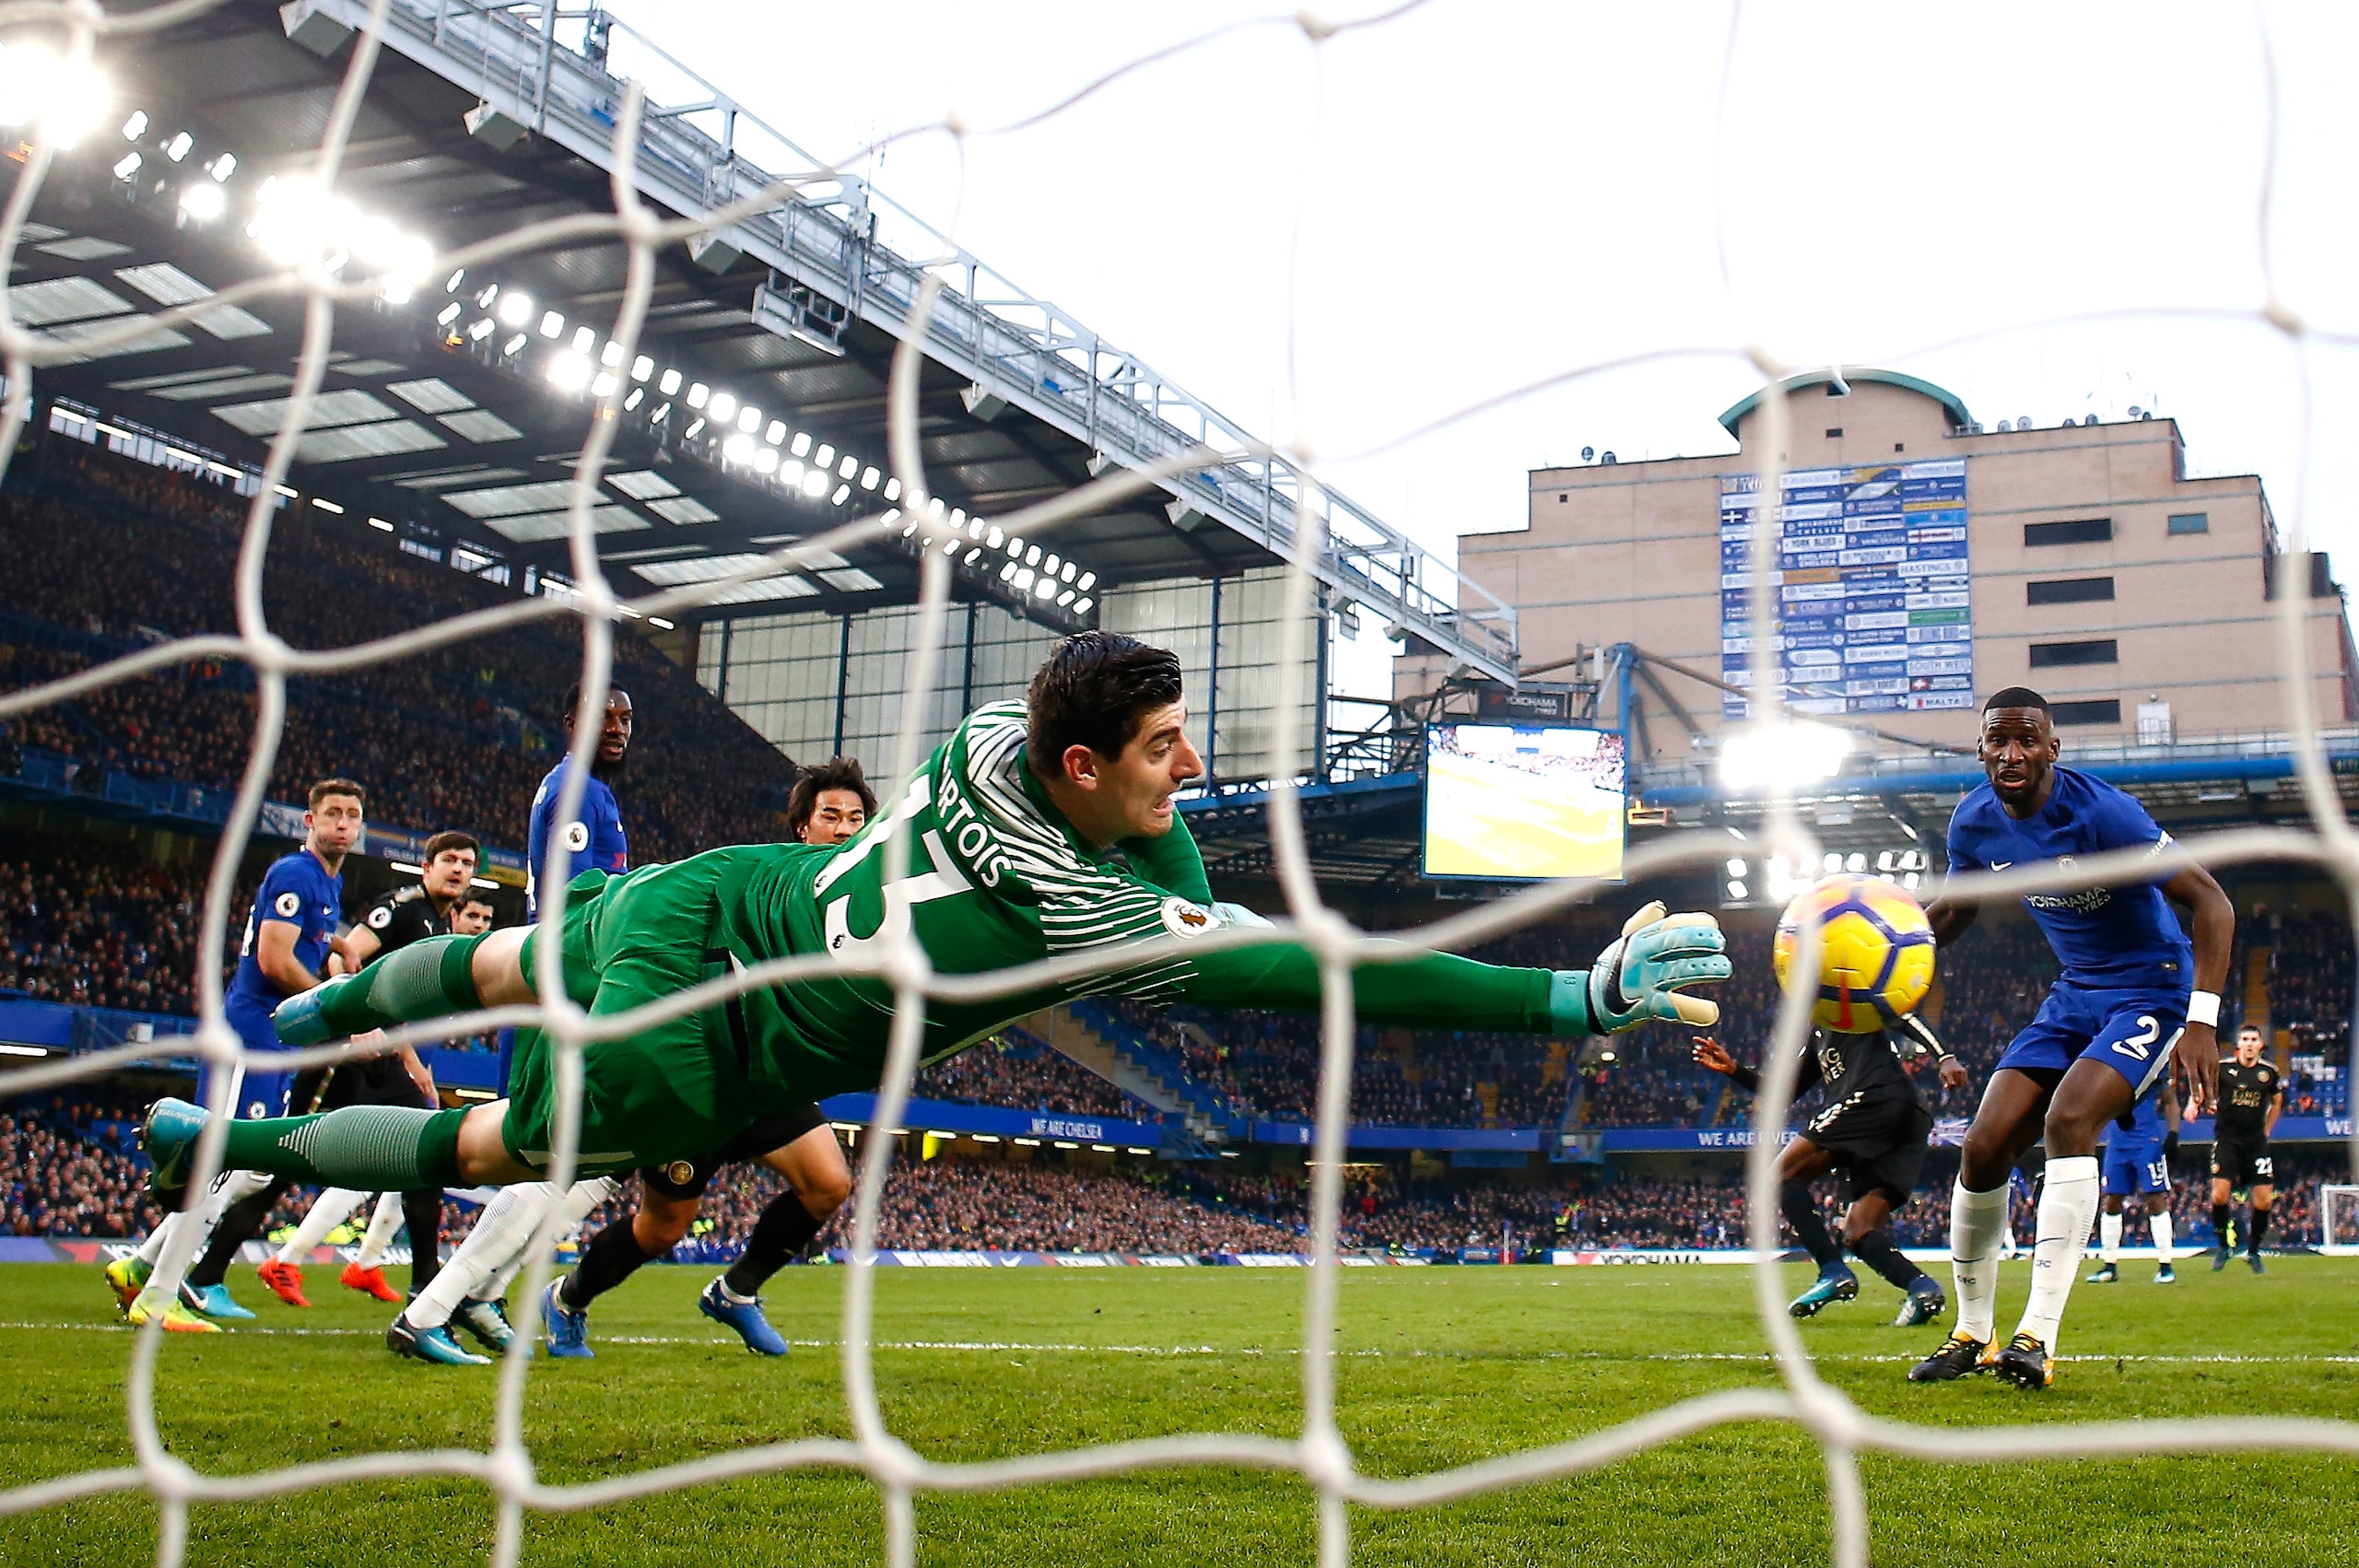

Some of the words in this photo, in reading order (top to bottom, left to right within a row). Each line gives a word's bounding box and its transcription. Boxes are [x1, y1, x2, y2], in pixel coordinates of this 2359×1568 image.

[1900, 563, 1951, 574] HASTINGS
[2025, 886, 2107, 909] YOKOHAMA
[2077, 894, 2111, 915] TYRES
[2124, 1015, 2160, 1059] 2
[1029, 1117, 1048, 1135] WE
[1047, 1119, 1065, 1137] ARE
[1064, 1121, 1104, 1140] CHELSEA
[1697, 1131, 1723, 1146] WE
[1725, 1131, 1755, 1146] ARE
[1601, 1254, 1702, 1265] YOKOHAMA
